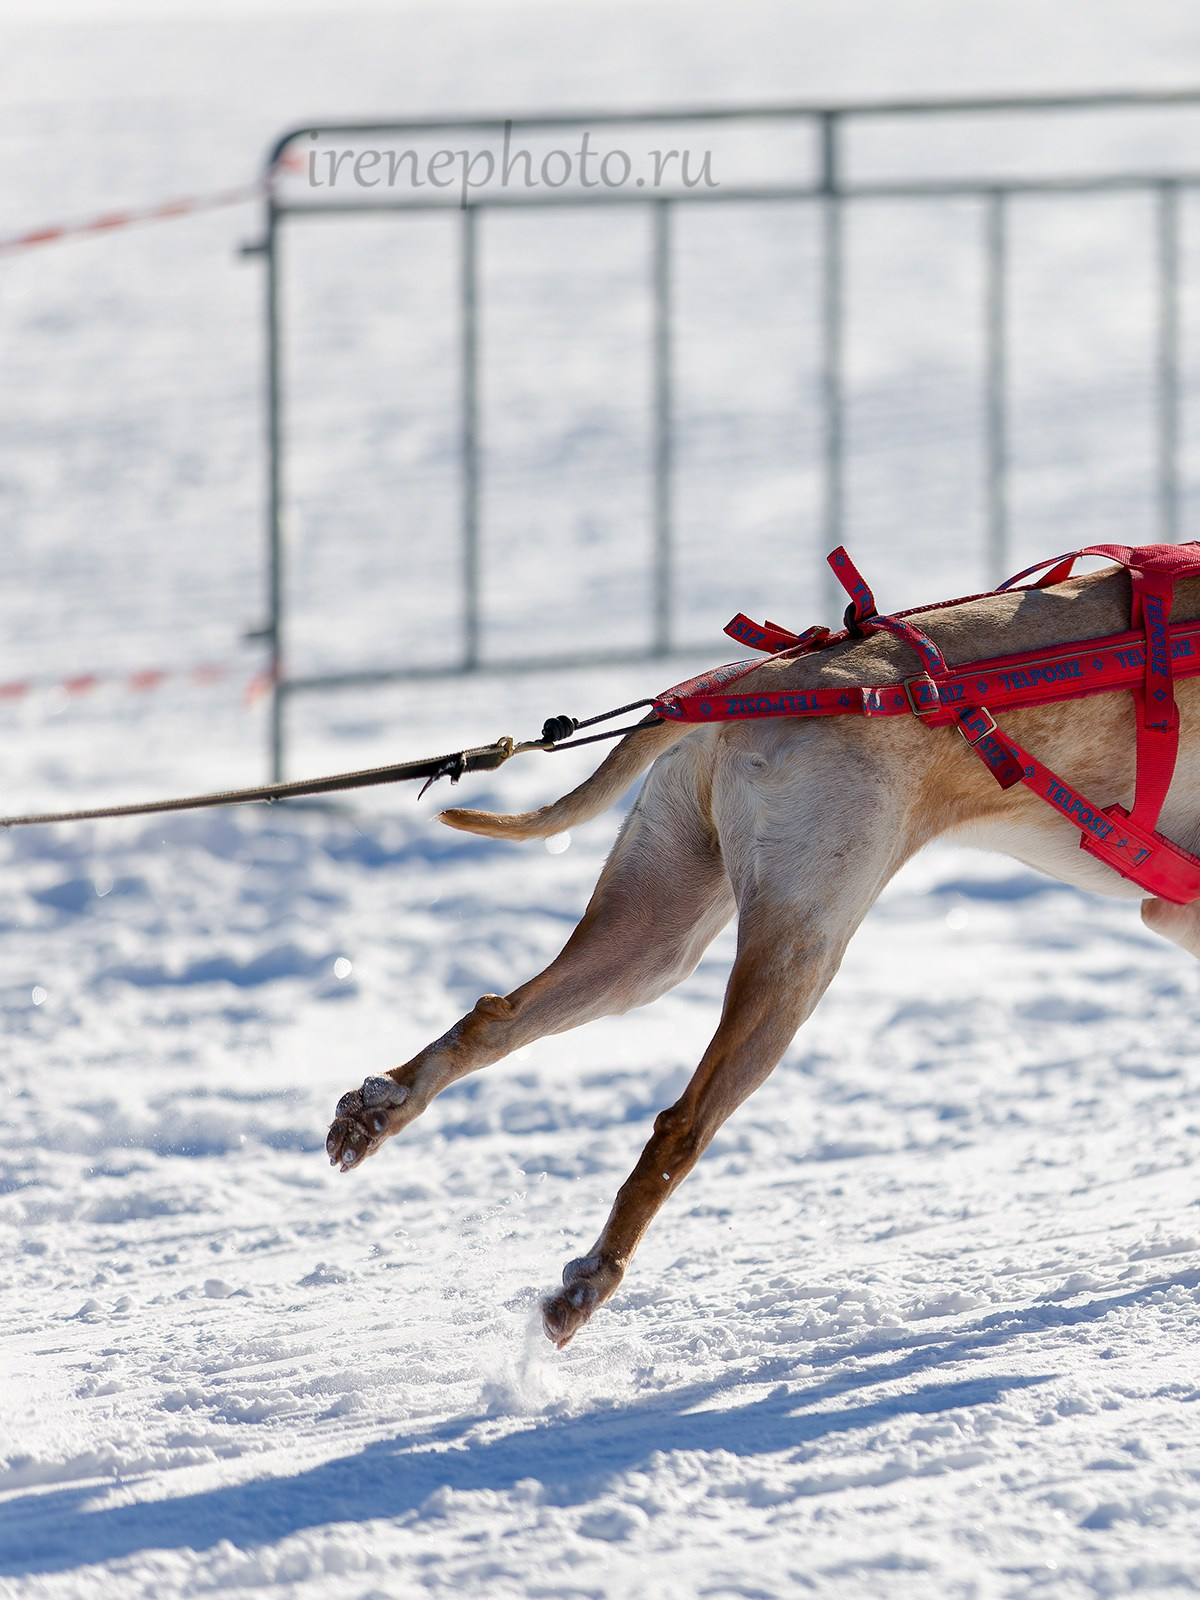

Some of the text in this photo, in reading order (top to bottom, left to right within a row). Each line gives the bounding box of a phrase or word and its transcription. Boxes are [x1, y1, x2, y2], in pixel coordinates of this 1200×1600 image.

[1147, 594, 1168, 677] TELPOSIZ
[1000, 660, 1084, 692] TELPOSIZ
[726, 694, 822, 716] TELPOSIZ
[1045, 778, 1116, 840] TELPOSIZ
